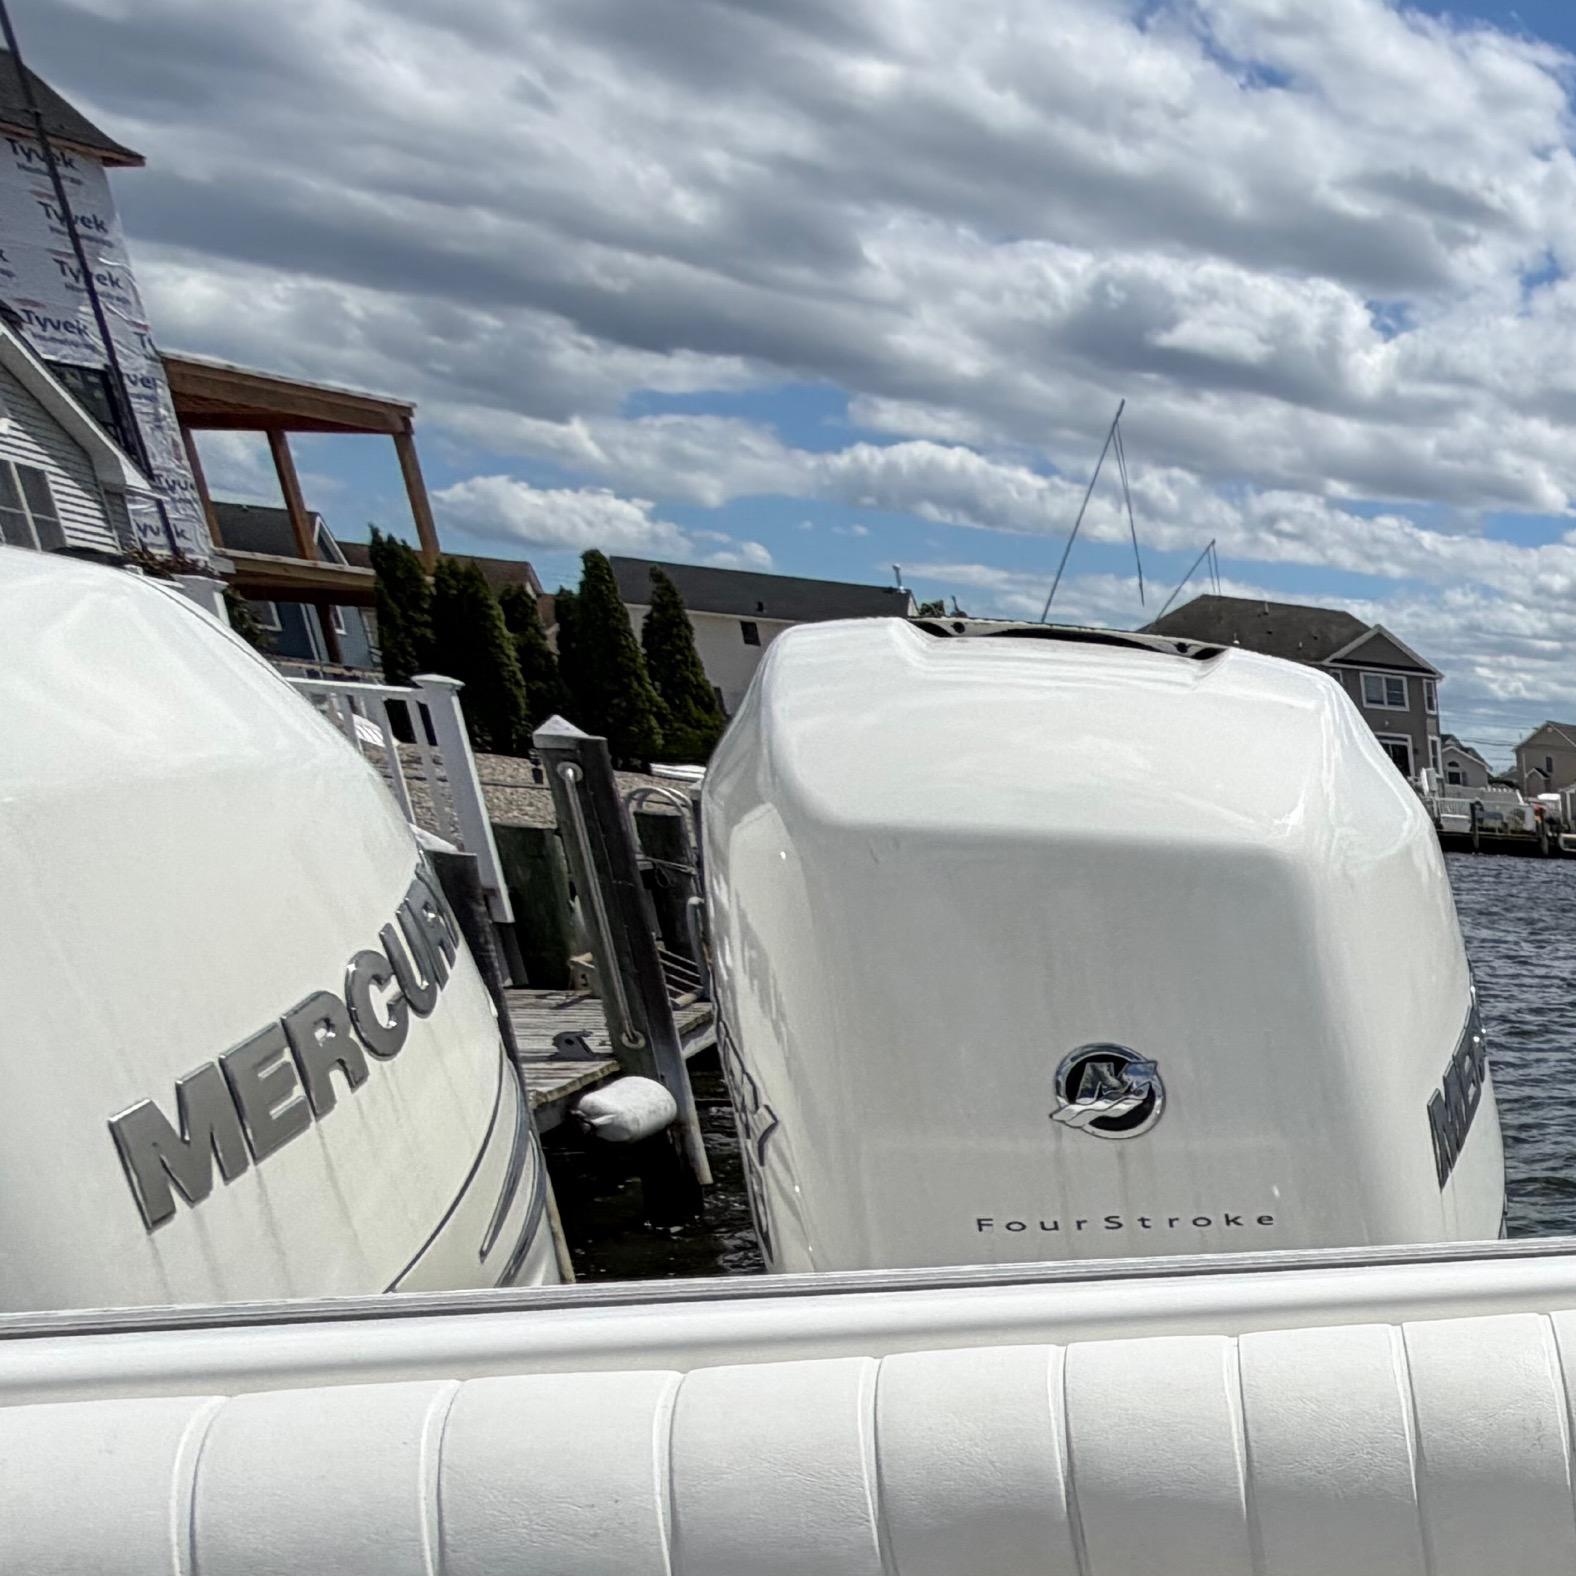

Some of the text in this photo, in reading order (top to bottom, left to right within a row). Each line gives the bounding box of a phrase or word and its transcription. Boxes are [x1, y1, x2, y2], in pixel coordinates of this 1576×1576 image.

[37, 201, 109, 234] Tyek
[52, 258, 123, 289] Tyek
[133, 519, 193, 541] yvk
[976, 1213, 1275, 1233] FourStroke
